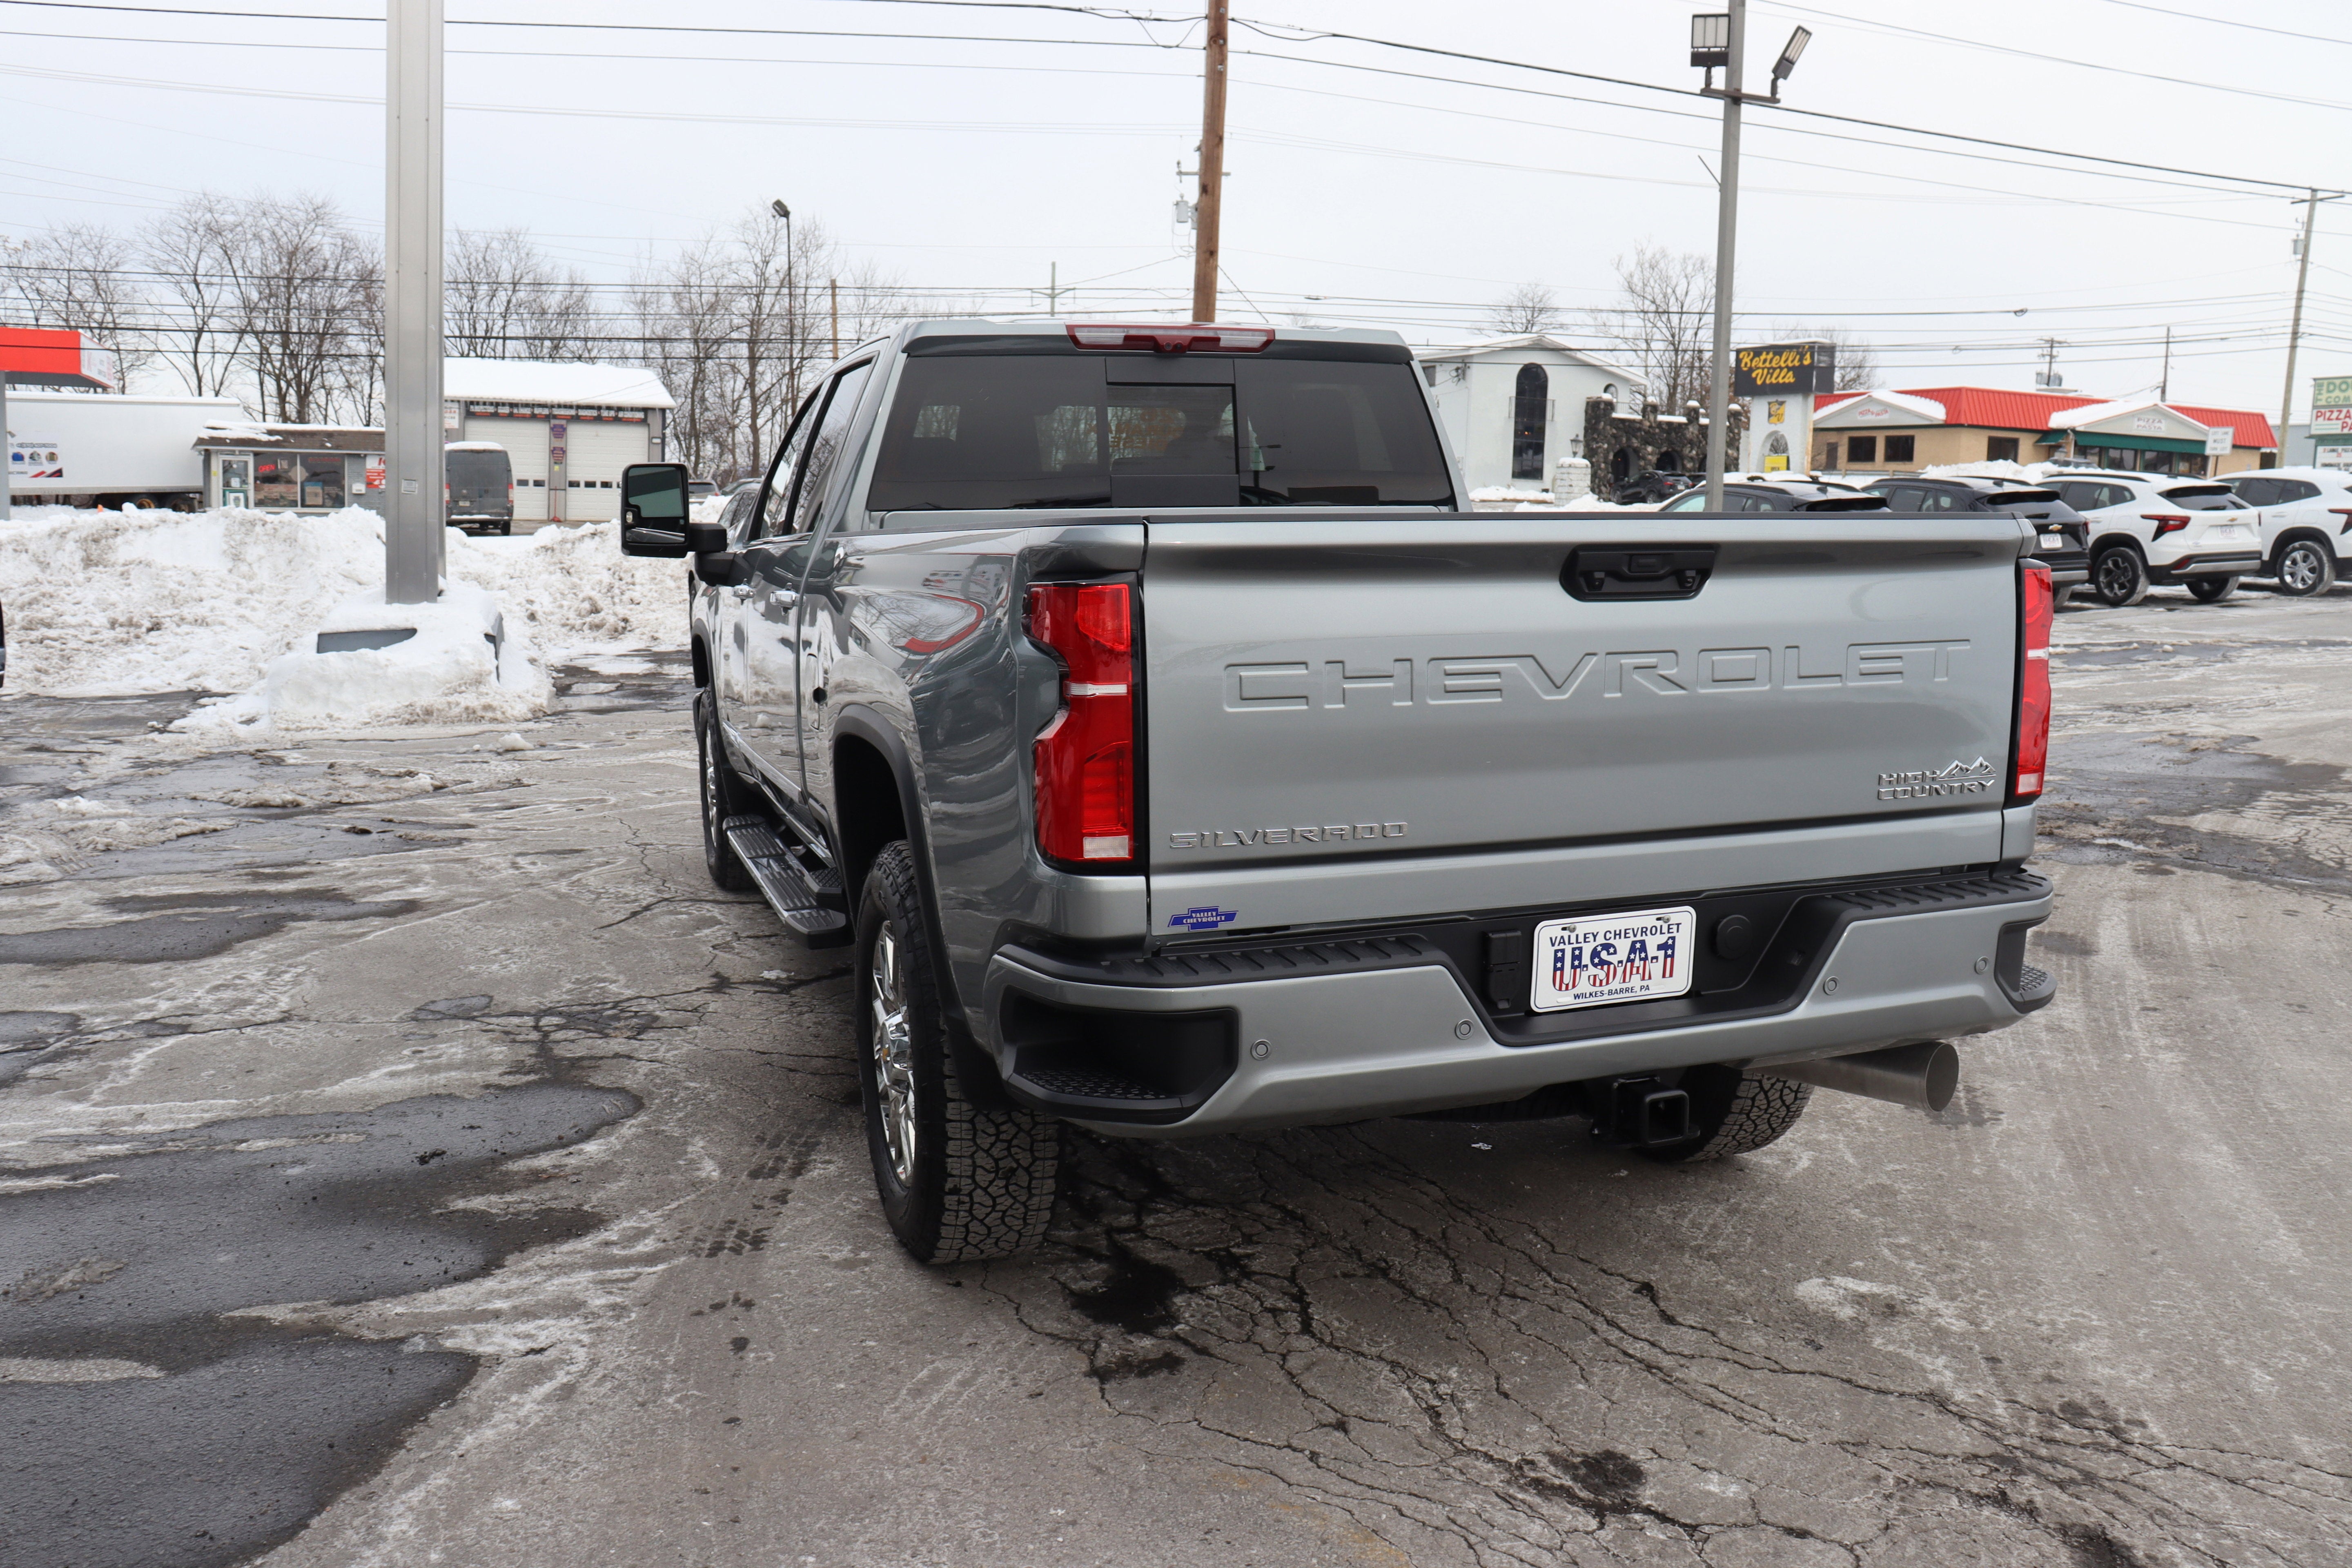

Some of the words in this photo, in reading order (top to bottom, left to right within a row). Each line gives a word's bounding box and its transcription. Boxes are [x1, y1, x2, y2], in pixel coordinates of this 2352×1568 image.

[1739, 345, 1812, 371] Bettelli's
[1752, 368, 1796, 385] Villa
[2315, 382, 2324, 404] THE
[2326, 380, 2352, 394] DO
[2315, 409, 2352, 421] PIZZA
[1223, 638, 1971, 712] CHEVROLET
[1879, 770, 1940, 785] HIGH
[1878, 780, 1995, 800] COUNTRY
[1170, 822, 1408, 848] SILVERADO
[1550, 931, 1599, 947] VALLEY
[1604, 923, 1682, 941] CHEVROLET
[1573, 986, 1637, 1000] WILKES-BARRE,
